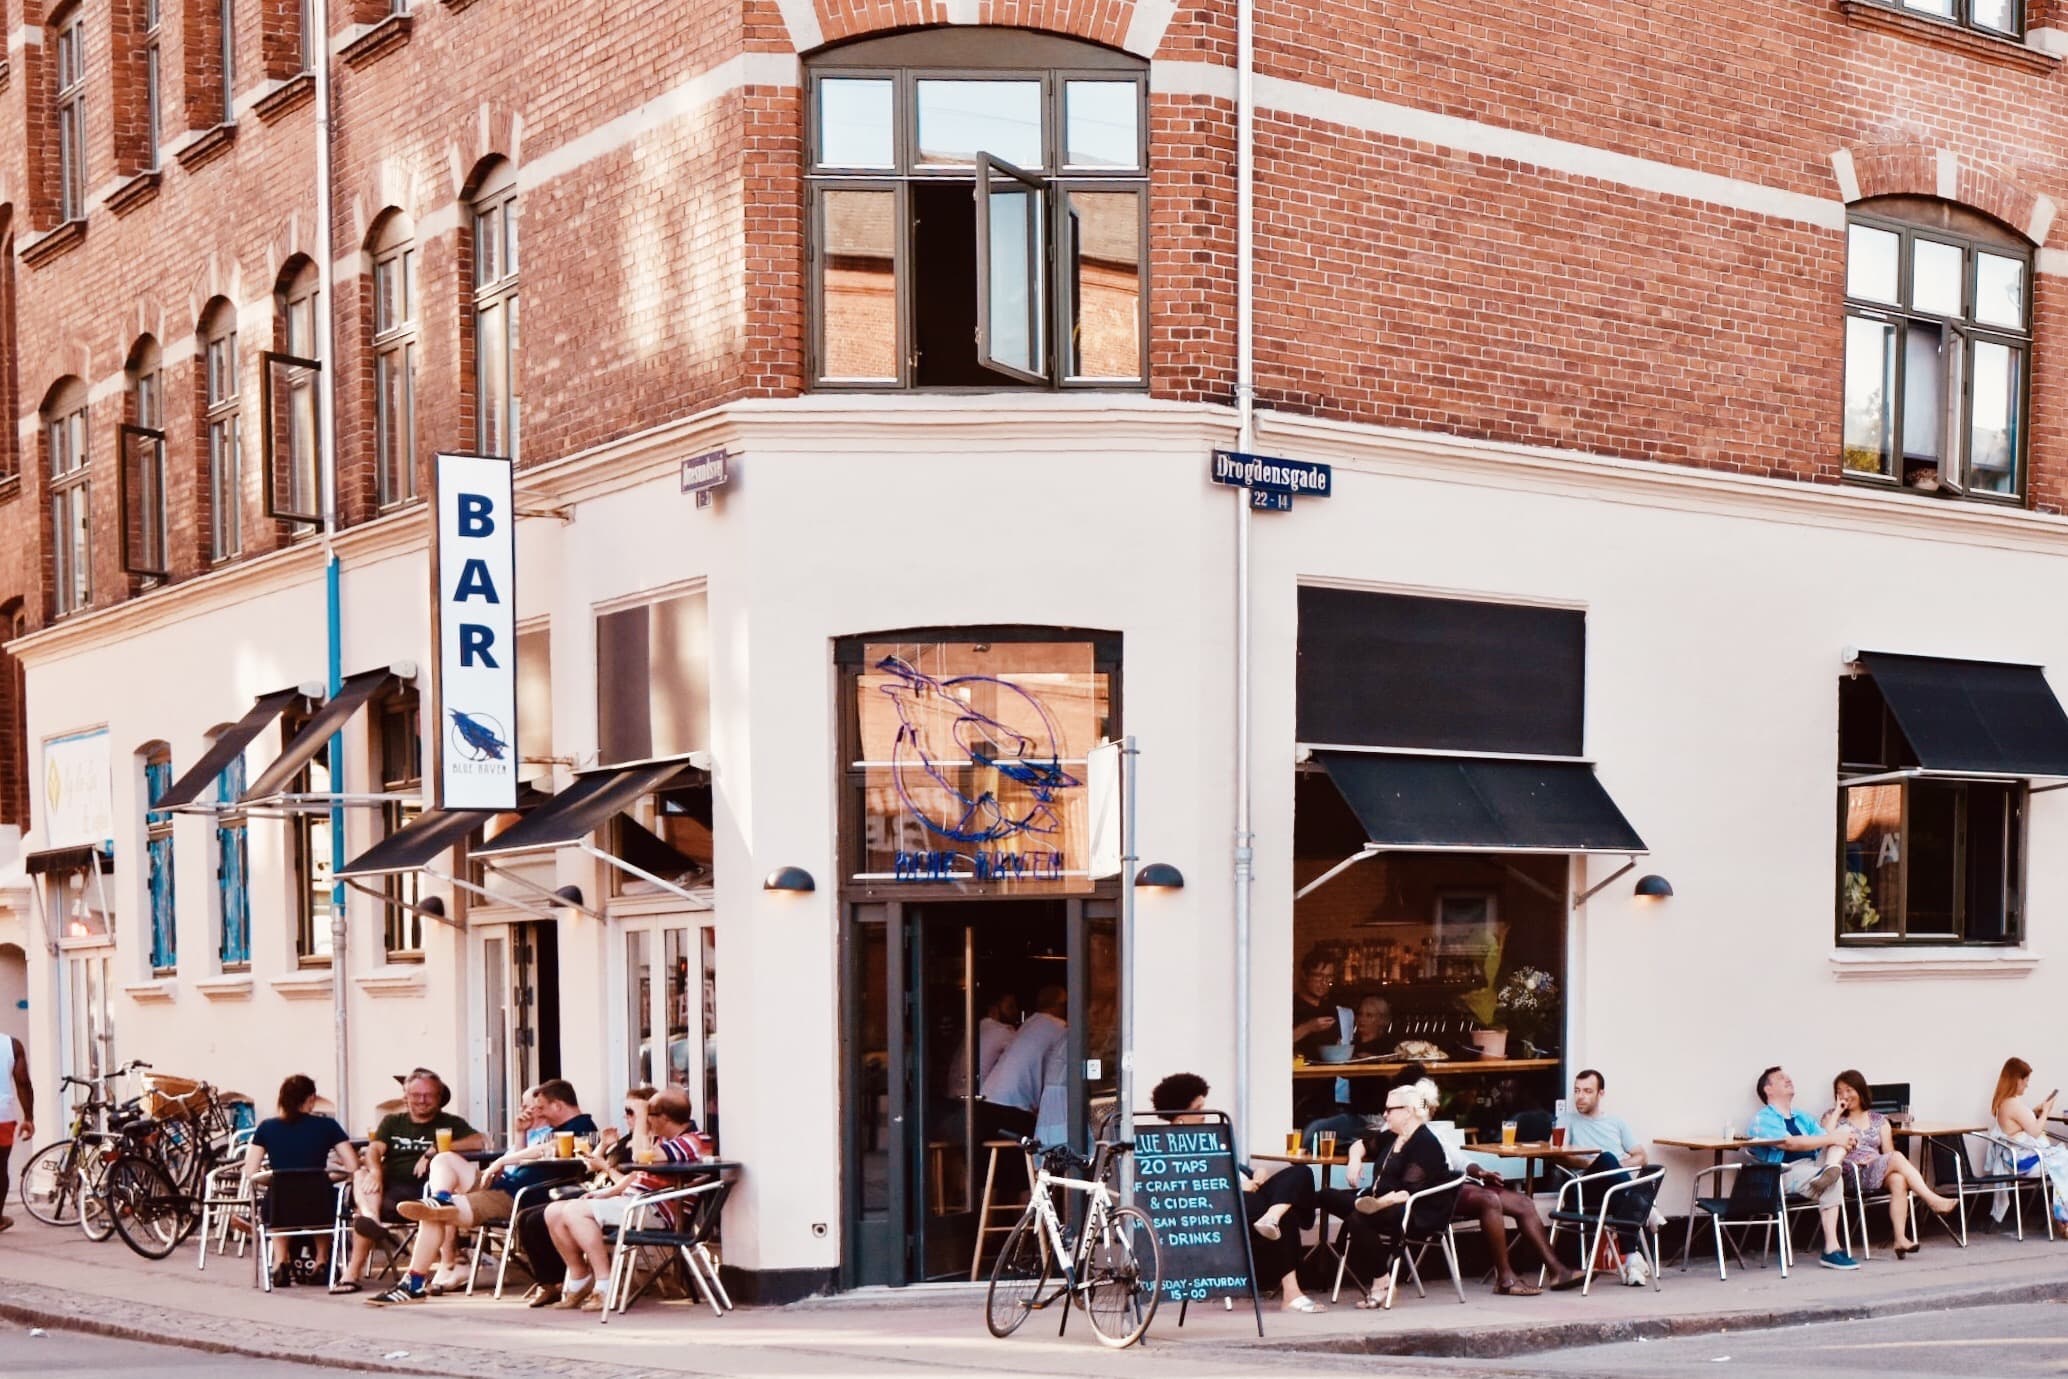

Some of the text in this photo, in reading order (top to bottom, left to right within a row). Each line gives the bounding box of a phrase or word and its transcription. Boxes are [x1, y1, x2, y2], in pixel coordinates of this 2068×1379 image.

[1216, 454, 1326, 491] Drogdensgade
[1254, 490, 1268, 506] 22
[1278, 494, 1289, 509] 14
[453, 493, 500, 668] BAR
[452, 763, 473, 774] BLUE
[1133, 1134, 1163, 1154] LUE
[1140, 1159, 1208, 1175] 20 TAPS
[1145, 1180, 1188, 1193] CRAFT
[1192, 1177, 1230, 1192] BEER
[1150, 1196, 1160, 1210] &
[1181, 1213, 1233, 1228] SPIRITS
[1168, 1231, 1222, 1246] DRINKS
